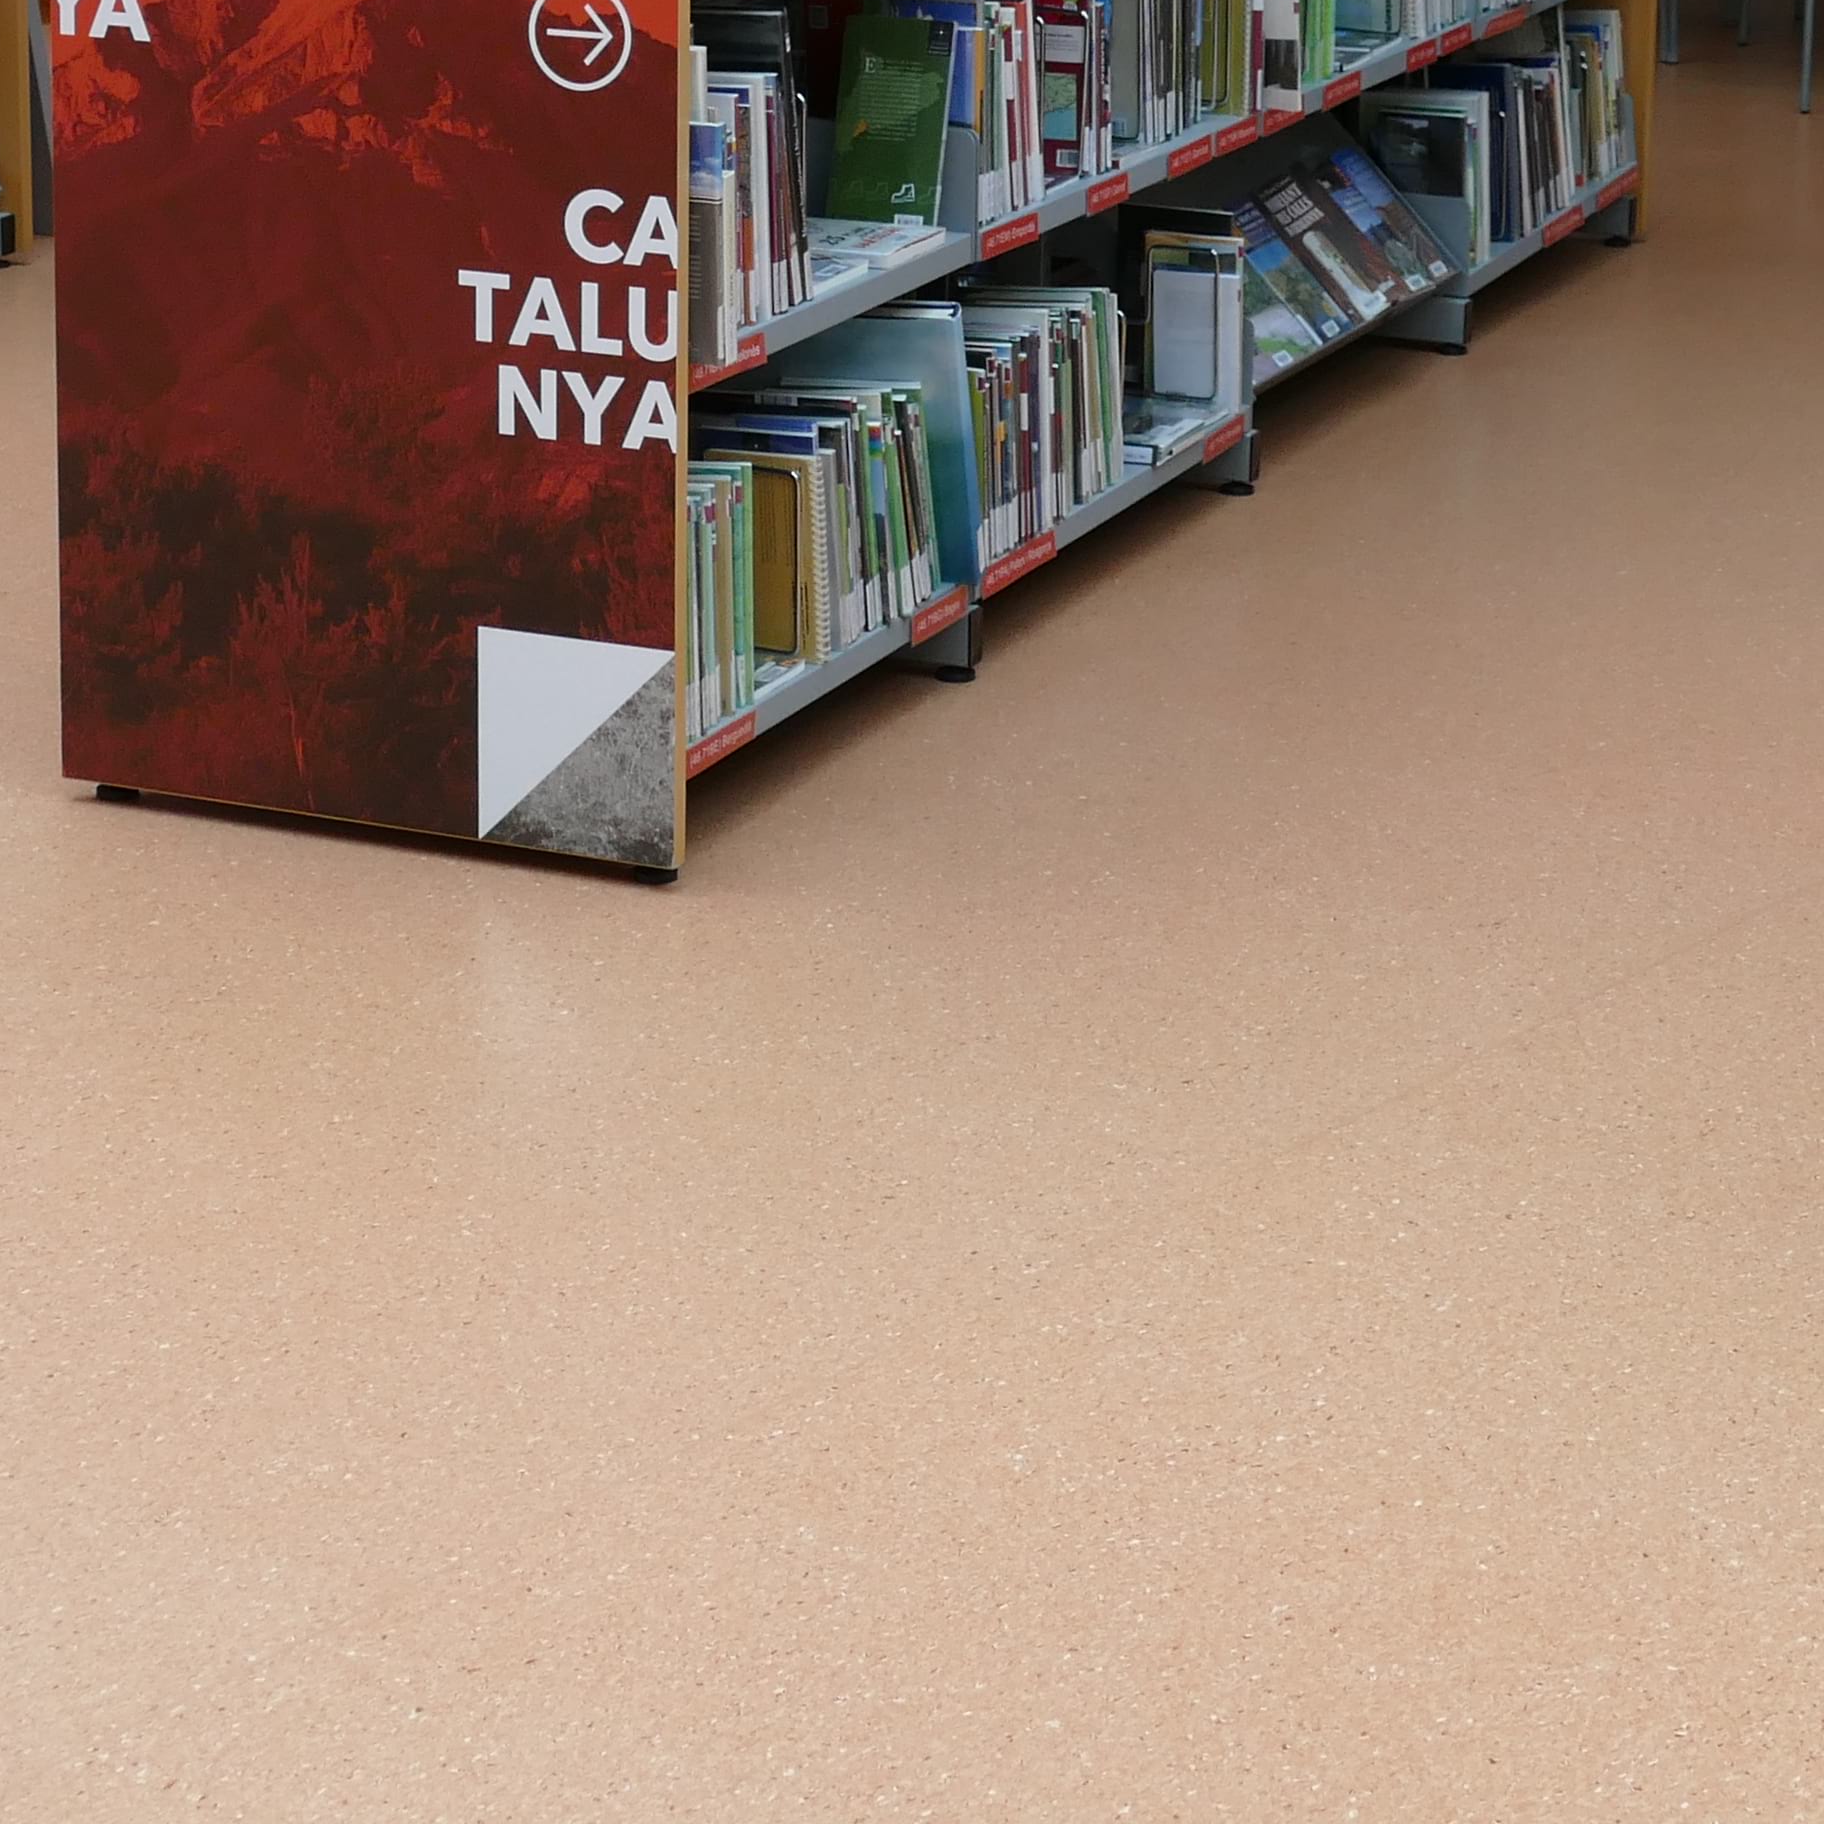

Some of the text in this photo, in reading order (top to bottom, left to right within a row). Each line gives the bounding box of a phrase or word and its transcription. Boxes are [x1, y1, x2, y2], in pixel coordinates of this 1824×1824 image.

[563, 187, 681, 273] CA
[457, 268, 681, 366] TALU
[497, 363, 679, 456] NYA
